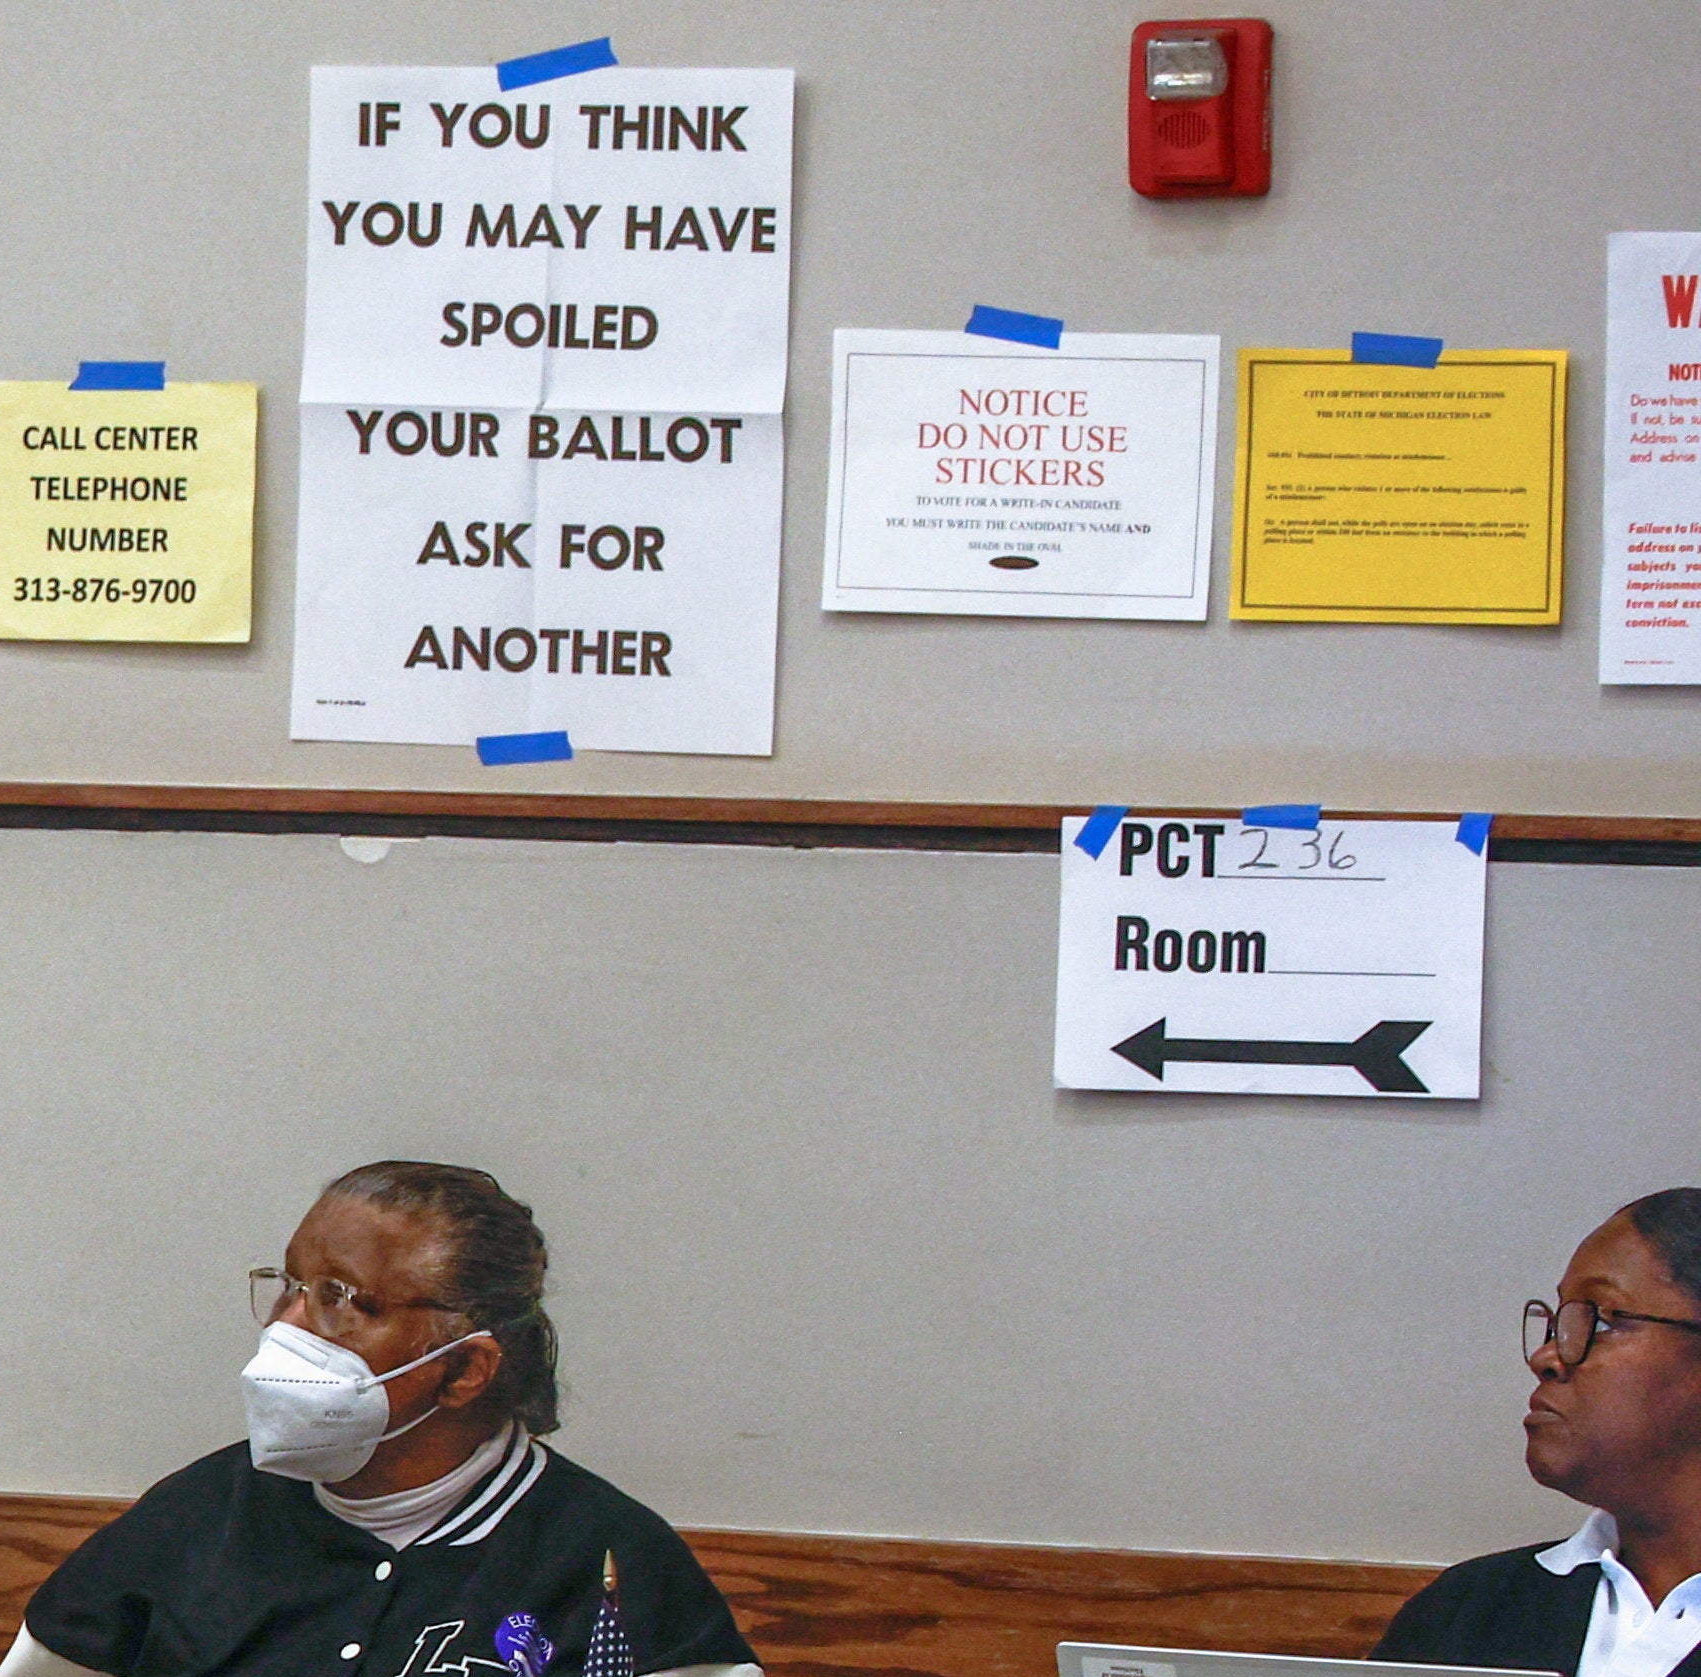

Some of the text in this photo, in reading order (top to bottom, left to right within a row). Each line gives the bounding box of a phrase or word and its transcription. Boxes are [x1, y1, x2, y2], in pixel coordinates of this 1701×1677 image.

[358, 102, 749, 152] IF YOU THINK
[322, 200, 777, 253] YOU MAY HAVE
[1662, 274, 1701, 328] W
[440, 301, 659, 351] SPOILED
[1669, 363, 1701, 381] NOT
[959, 389, 1089, 417] NOTICE
[1630, 394, 1698, 407] Do we have
[1669, 412, 1684, 425] be
[22, 426, 198, 451] CALL CENTER
[345, 409, 743, 464] YOUR BALLOT
[918, 423, 1128, 453] DO NOT USE
[1630, 431, 1700, 444] Address on
[1629, 449, 1696, 464] and advise
[936, 457, 1105, 487] STICKERS
[30, 476, 187, 502] TELEPHONE
[916, 496, 932, 506] TO
[933, 496, 962, 507] VOTE
[964, 498, 987, 507] FOR
[1001, 498, 1053, 509] WRITE-IN
[1055, 500, 1122, 510] CANDIDATE
[886, 517, 1152, 534] YOU MUST WRITE THE CANDIDATE'S NAME AND
[1628, 522, 1672, 534] Failure
[1675, 524, 1687, 534] to
[47, 527, 168, 553] NUMBER
[416, 520, 665, 572] ASK FOR
[1628, 541, 1694, 552] address on
[1627, 560, 1677, 573] subjects
[13, 577, 197, 604] 313-876-9700
[1626, 579, 1701, 592] imprisonmen
[1625, 598, 1655, 609] term
[1657, 598, 1678, 609] not
[1625, 616, 1690, 628] conviction.
[403, 625, 672, 677] ANOTHER
[1116, 822, 1357, 879] PCT 236
[1114, 915, 1267, 974] Room
